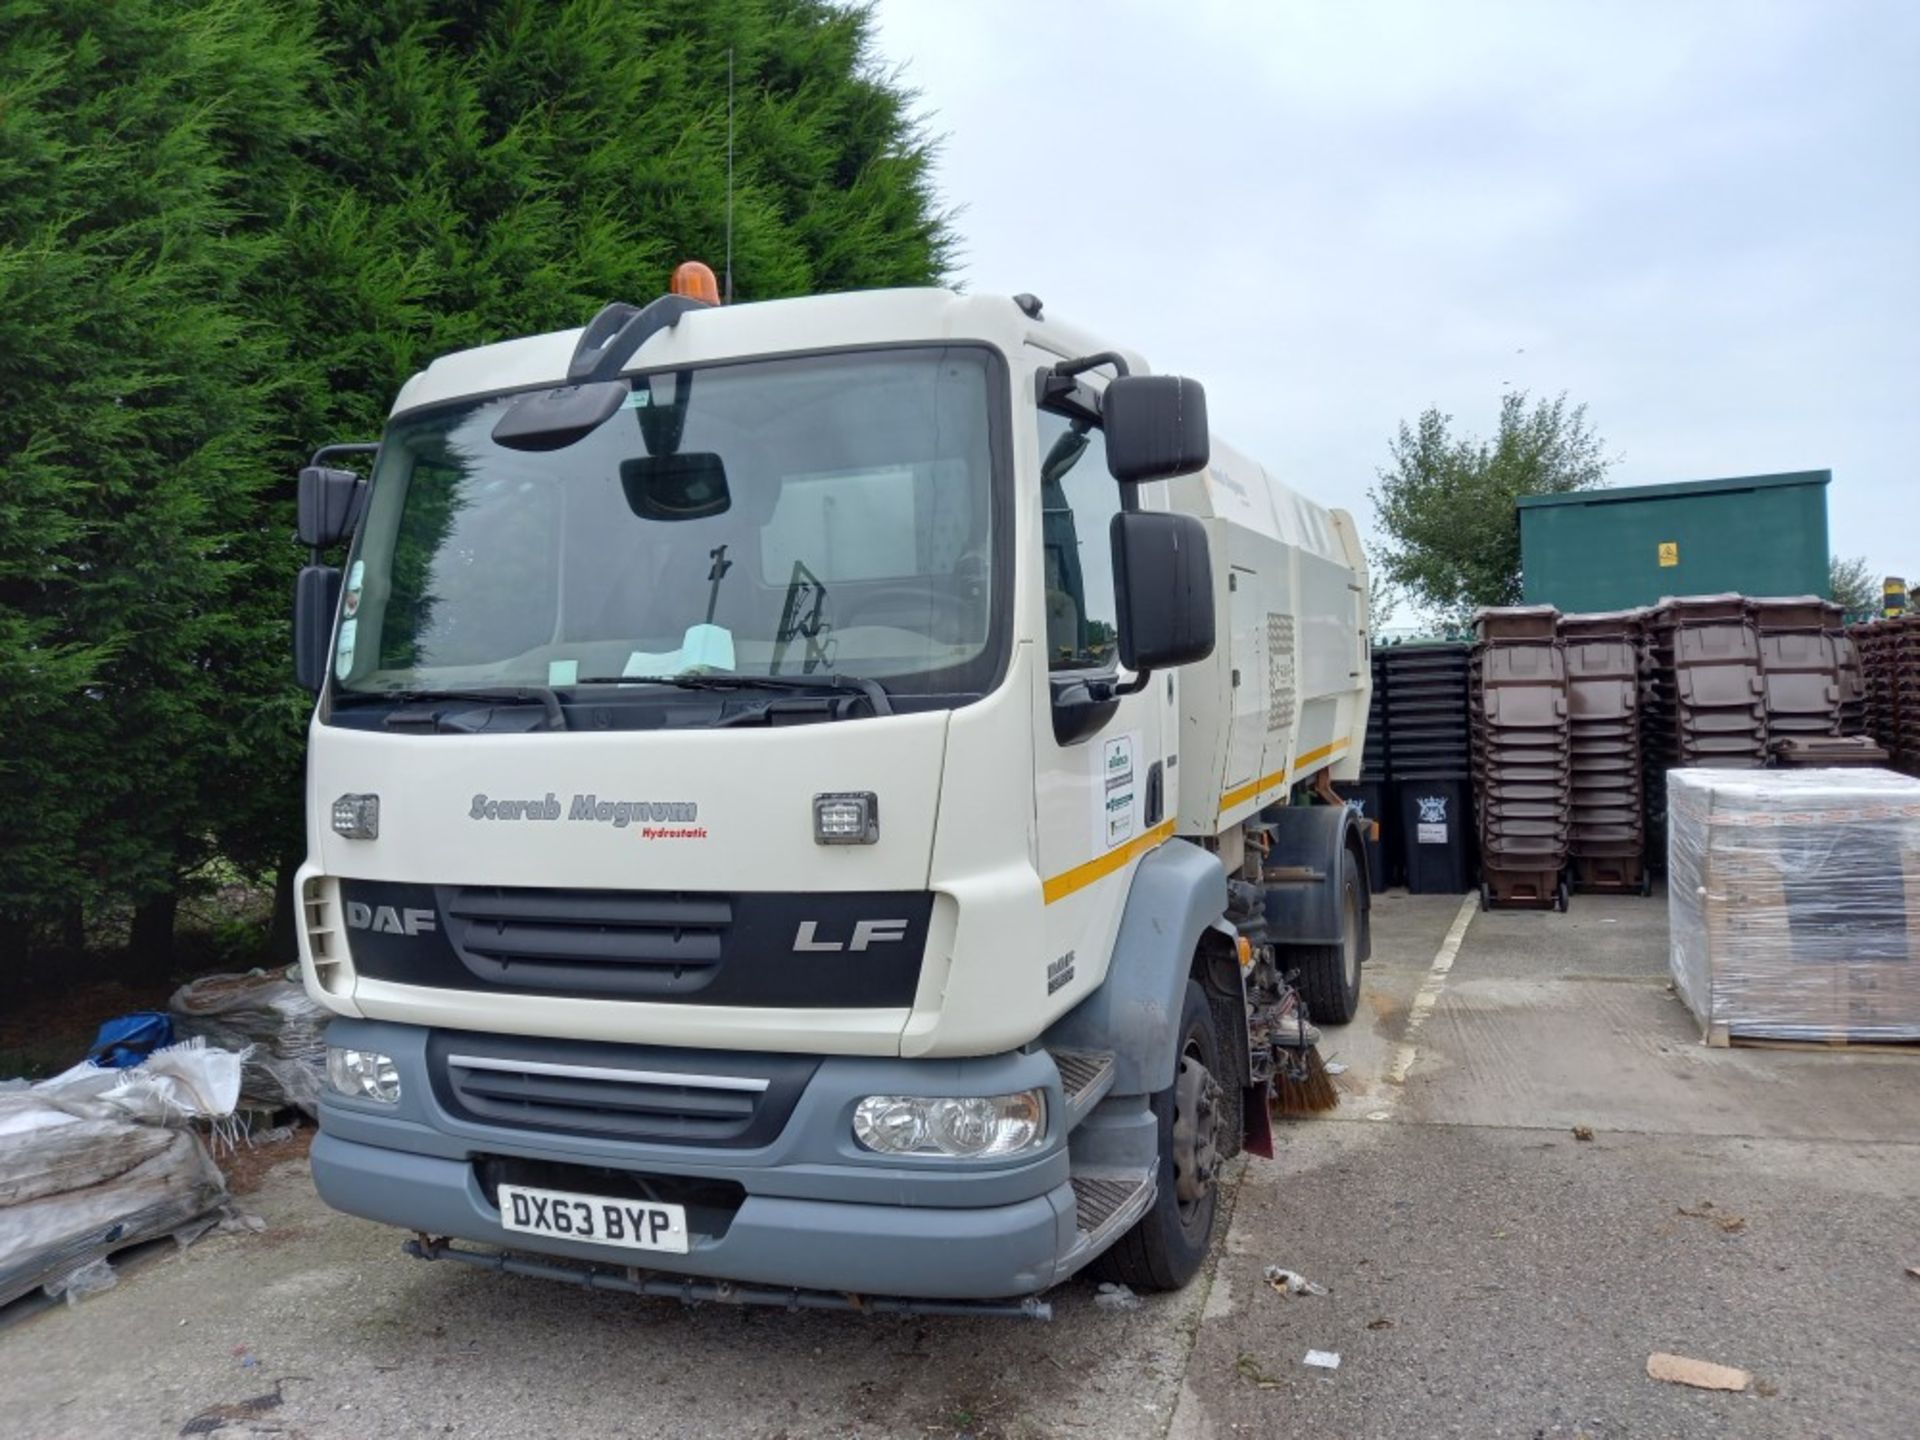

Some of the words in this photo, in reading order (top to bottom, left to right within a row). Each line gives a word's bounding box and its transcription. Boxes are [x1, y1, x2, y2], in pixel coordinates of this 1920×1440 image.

[469, 793, 561, 820] Scarab
[568, 794, 698, 828] Magnum
[642, 827, 707, 840] Hydrostatic
[346, 901, 436, 936] DAF
[793, 919, 908, 951] LF
[510, 1192, 594, 1236] DX63
[602, 1205, 669, 1244] BYP
